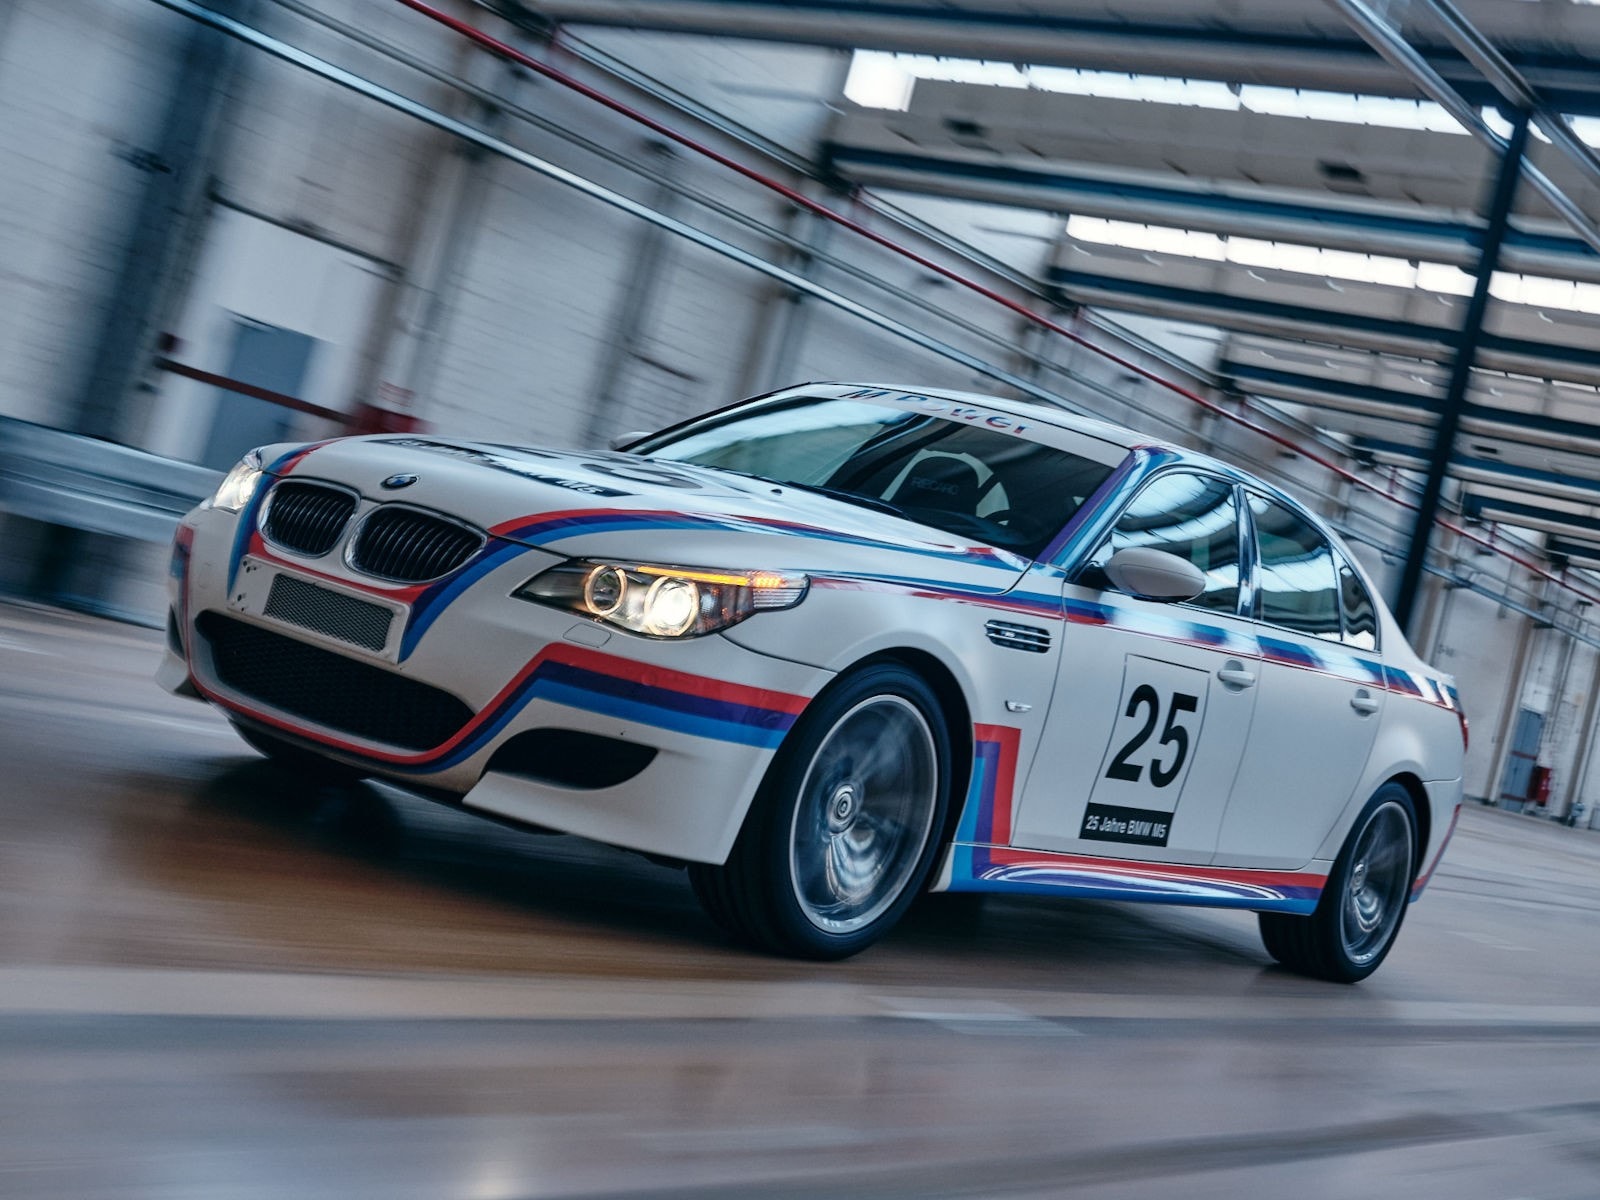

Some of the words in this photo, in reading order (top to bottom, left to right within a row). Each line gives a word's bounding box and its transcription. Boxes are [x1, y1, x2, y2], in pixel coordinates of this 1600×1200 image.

[837, 389, 891, 399] M
[895, 394, 1034, 434] Power
[1105, 684, 1198, 788] 25
[1085, 815, 1100, 830] 25
[1099, 817, 1127, 834] Jahre
[1126, 820, 1153, 836] BMW
[1151, 822, 1168, 838] M5
